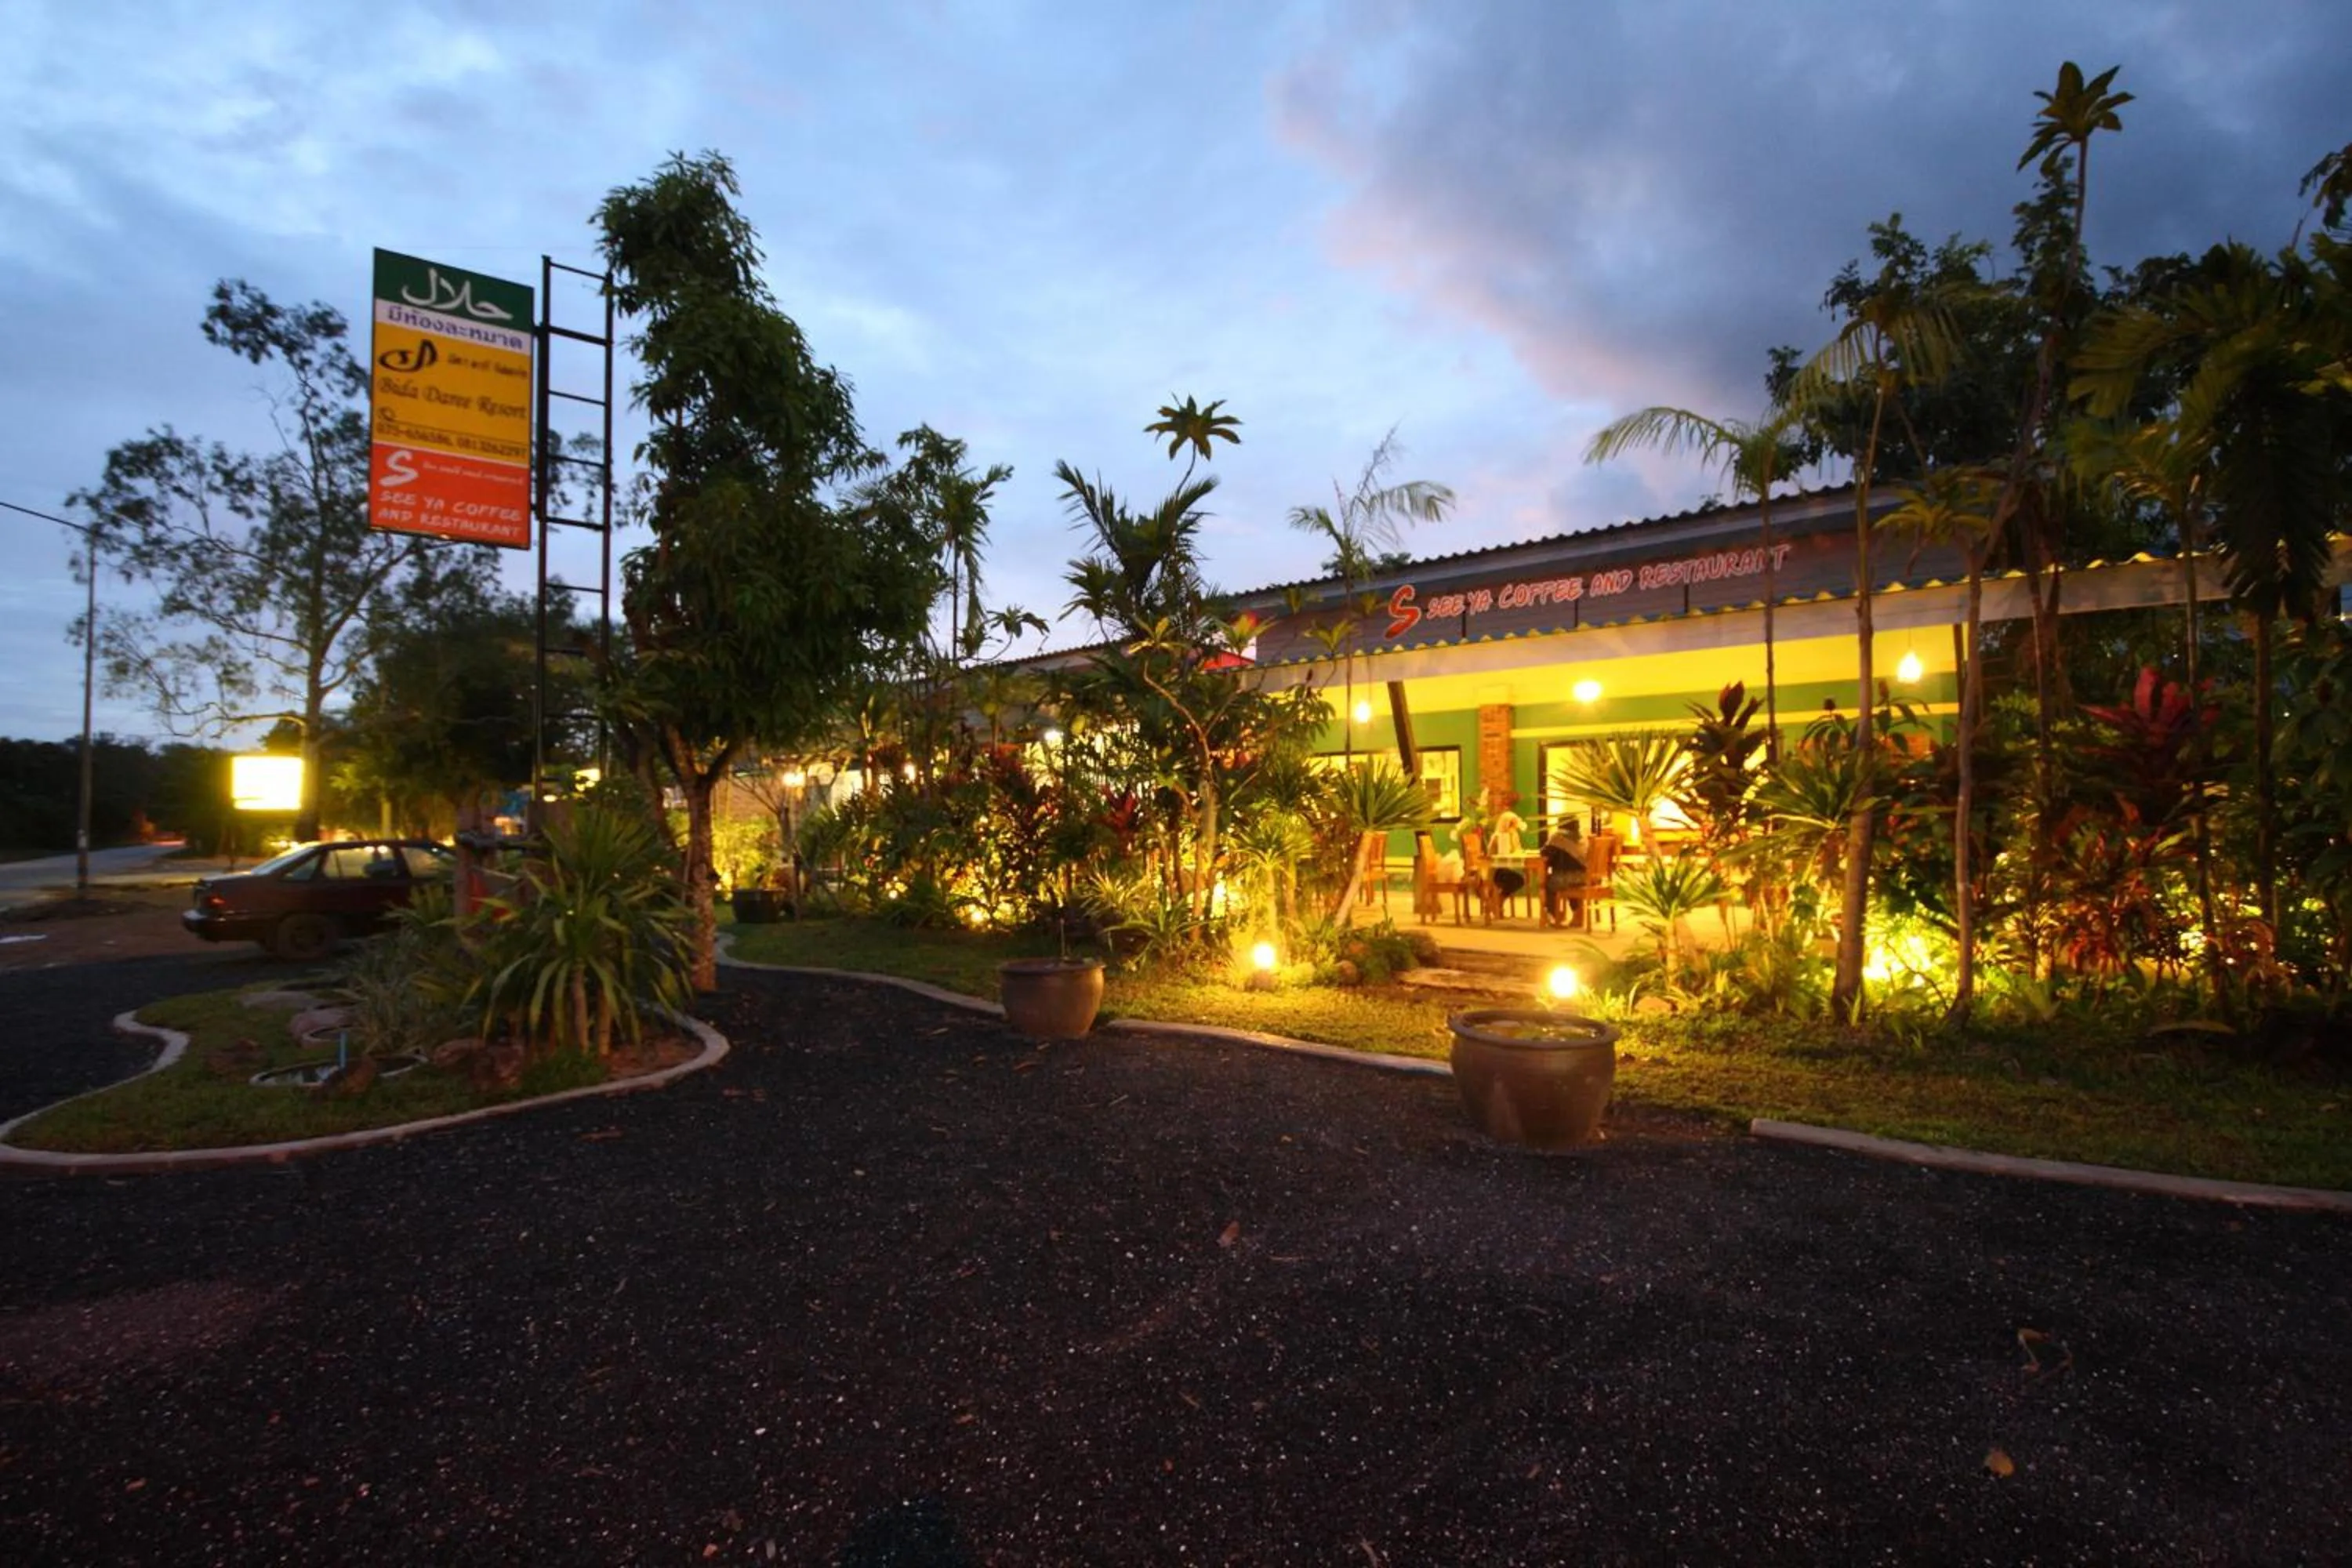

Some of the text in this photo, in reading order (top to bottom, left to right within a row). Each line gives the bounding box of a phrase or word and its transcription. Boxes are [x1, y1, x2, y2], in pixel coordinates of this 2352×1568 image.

[401, 267, 514, 320] حلال
[377, 507, 521, 537] AND RESTAURANT
[379, 490, 521, 522] SEE YA COFFEE
[1384, 584, 1421, 641] S
[1426, 594, 1465, 620] SEE
[1467, 589, 1493, 615] YA
[1498, 577, 1584, 609] COFFEE
[1589, 569, 1633, 597] AND
